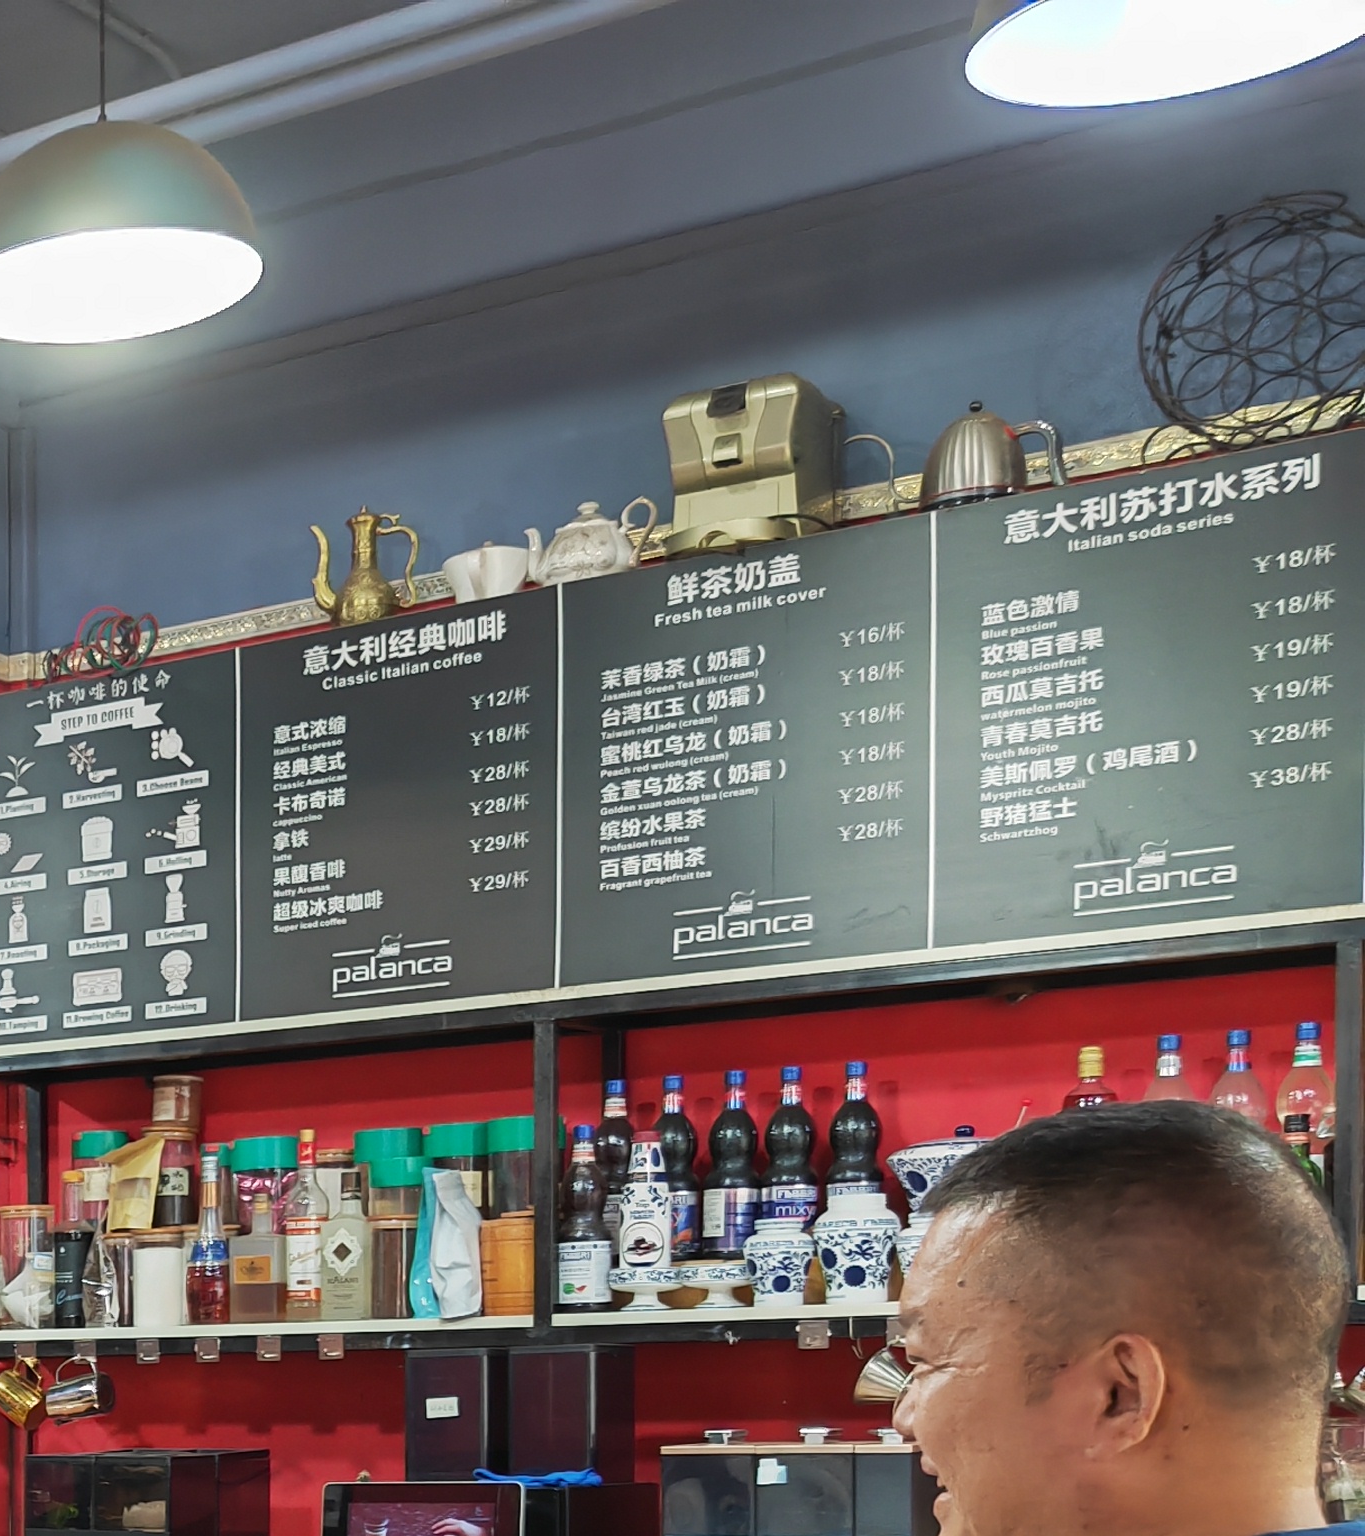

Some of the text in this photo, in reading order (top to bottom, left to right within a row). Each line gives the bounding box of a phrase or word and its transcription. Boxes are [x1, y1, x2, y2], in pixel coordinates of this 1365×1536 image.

[1003, 452, 1322, 545] 意大利苏打水系列
[1067, 511, 1235, 553] Italian soda series
[666, 553, 801, 607] 鲜茶奶盖
[654, 584, 827, 628] Fresh tea milk cover
[981, 589, 1080, 626] 蓝色激情
[302, 609, 507, 676] 意大利经典咖啡
[980, 627, 1105, 666] 玫瑰百香果
[981, 620, 1058, 640] Blue passion
[322, 650, 482, 691] Classic Italian coffee
[981, 655, 1088, 681] Rose passionfruit
[26, 669, 171, 710] 一杯咖啡的使命
[644, 683, 675, 697] Green
[676, 679, 696, 691] Tea
[980, 668, 1105, 708] 西瓜莫吉托
[61, 705, 135, 731] STEP TO COFFEE
[980, 695, 1097, 722] watermelon mojito
[273, 715, 347, 745] 意式浓缩
[637, 724, 653, 735] red
[980, 710, 1104, 749] 青春莫吉托
[273, 751, 346, 780] 经典美式
[980, 742, 1059, 762] Youth Mojito
[273, 786, 346, 816] 卡布奇诺
[979, 797, 1078, 829] 野猪猛士
[273, 828, 309, 851] 拿铁
[599, 808, 707, 841] 缤纷水果茶
[674, 834, 690, 843] tea
[599, 846, 707, 880] 百香西柚茶
[599, 877, 642, 892] Fragrant
[696, 869, 713, 879] tea
[1073, 863, 1238, 910] palanca
[272, 889, 385, 922] 超级冰爽咖啡
[672, 912, 814, 954] palanca
[332, 955, 453, 992] palanca
